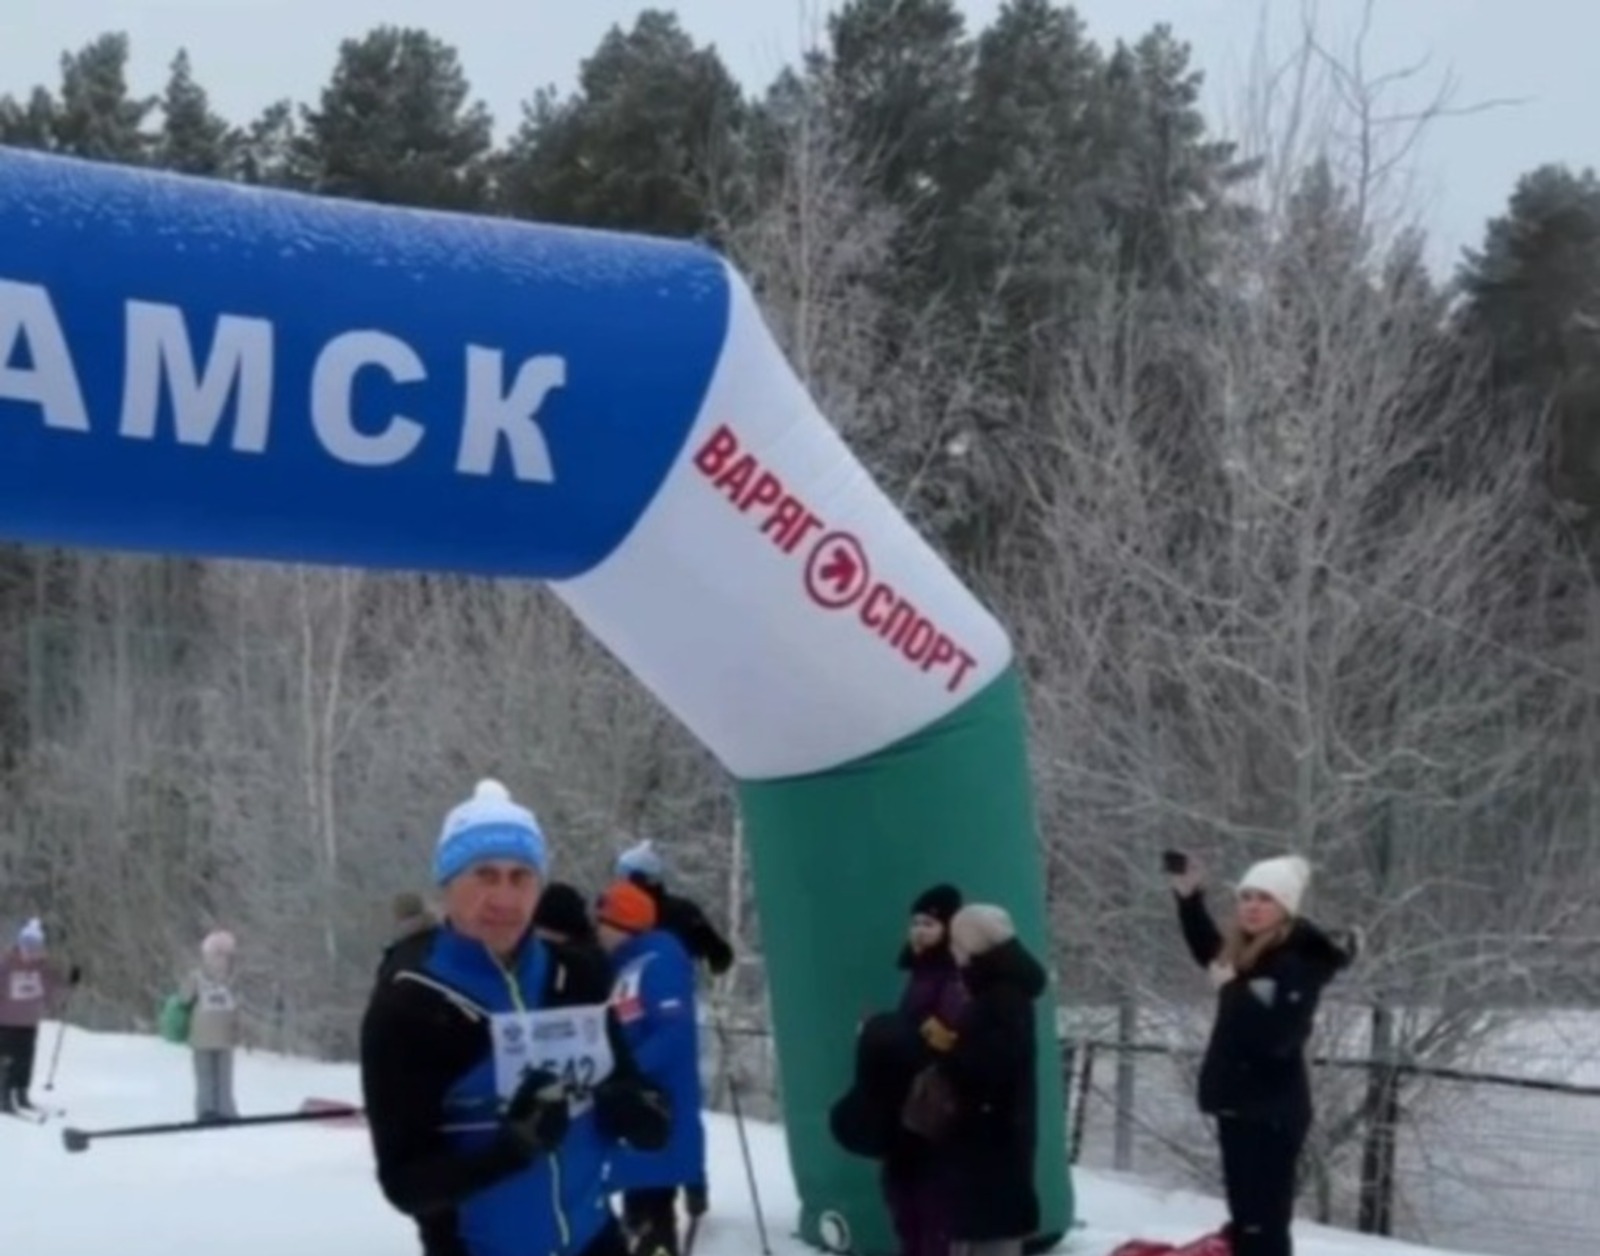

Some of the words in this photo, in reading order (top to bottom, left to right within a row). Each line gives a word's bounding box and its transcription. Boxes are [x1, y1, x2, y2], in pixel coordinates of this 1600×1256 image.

[0, 278, 566, 483] АМСК
[693, 424, 824, 554] ВАРЯГ
[860, 583, 977, 692] СПОРТ
